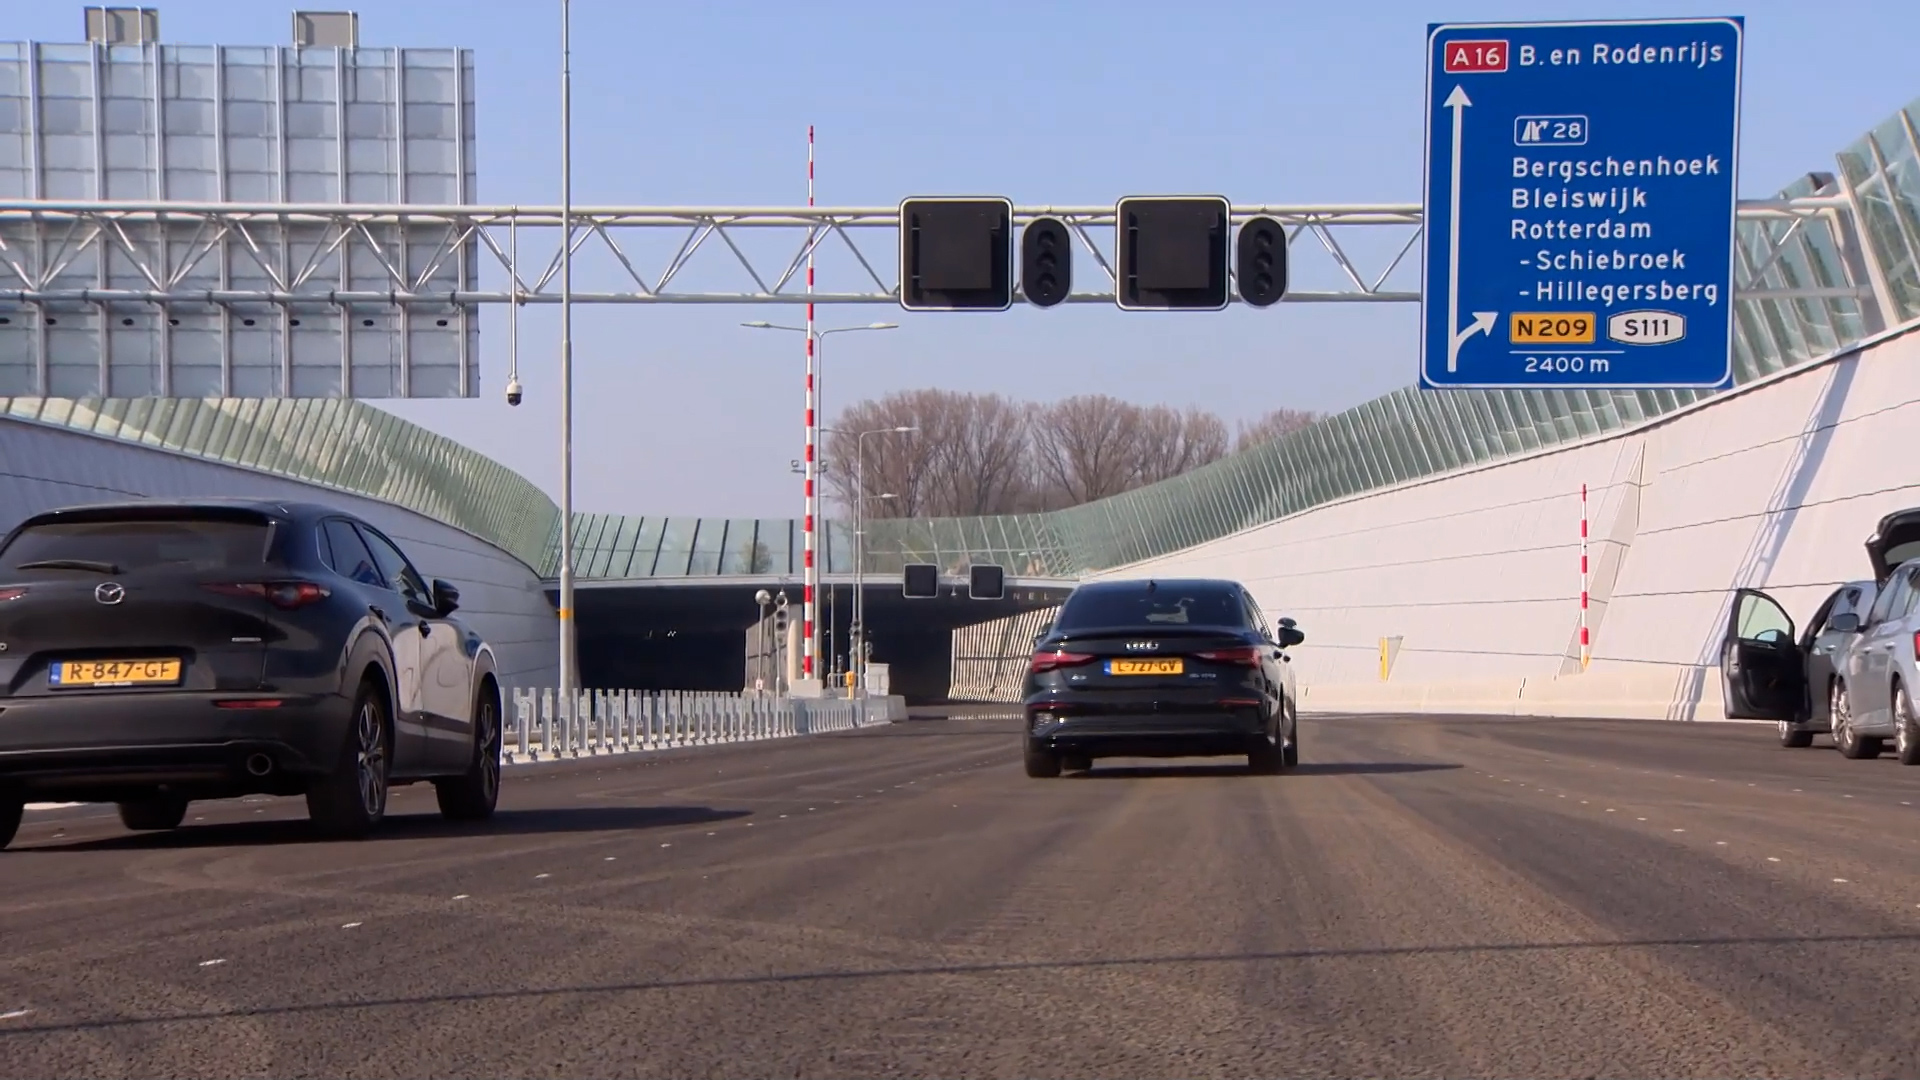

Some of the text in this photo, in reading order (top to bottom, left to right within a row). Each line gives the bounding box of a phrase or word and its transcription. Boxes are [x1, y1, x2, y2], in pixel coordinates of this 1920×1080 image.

[1593, 41, 1723, 69] Rodenrijs
[1553, 122, 1582, 139] 28
[1512, 154, 1720, 184] Bergschenhoek
[1512, 187, 1647, 214] Bleiswijk
[1511, 218, 1651, 240] Rotterdam
[1624, 318, 1669, 337] S111
[1525, 356, 1609, 373] 2400 m
[70, 660, 171, 680] R-847-GF
